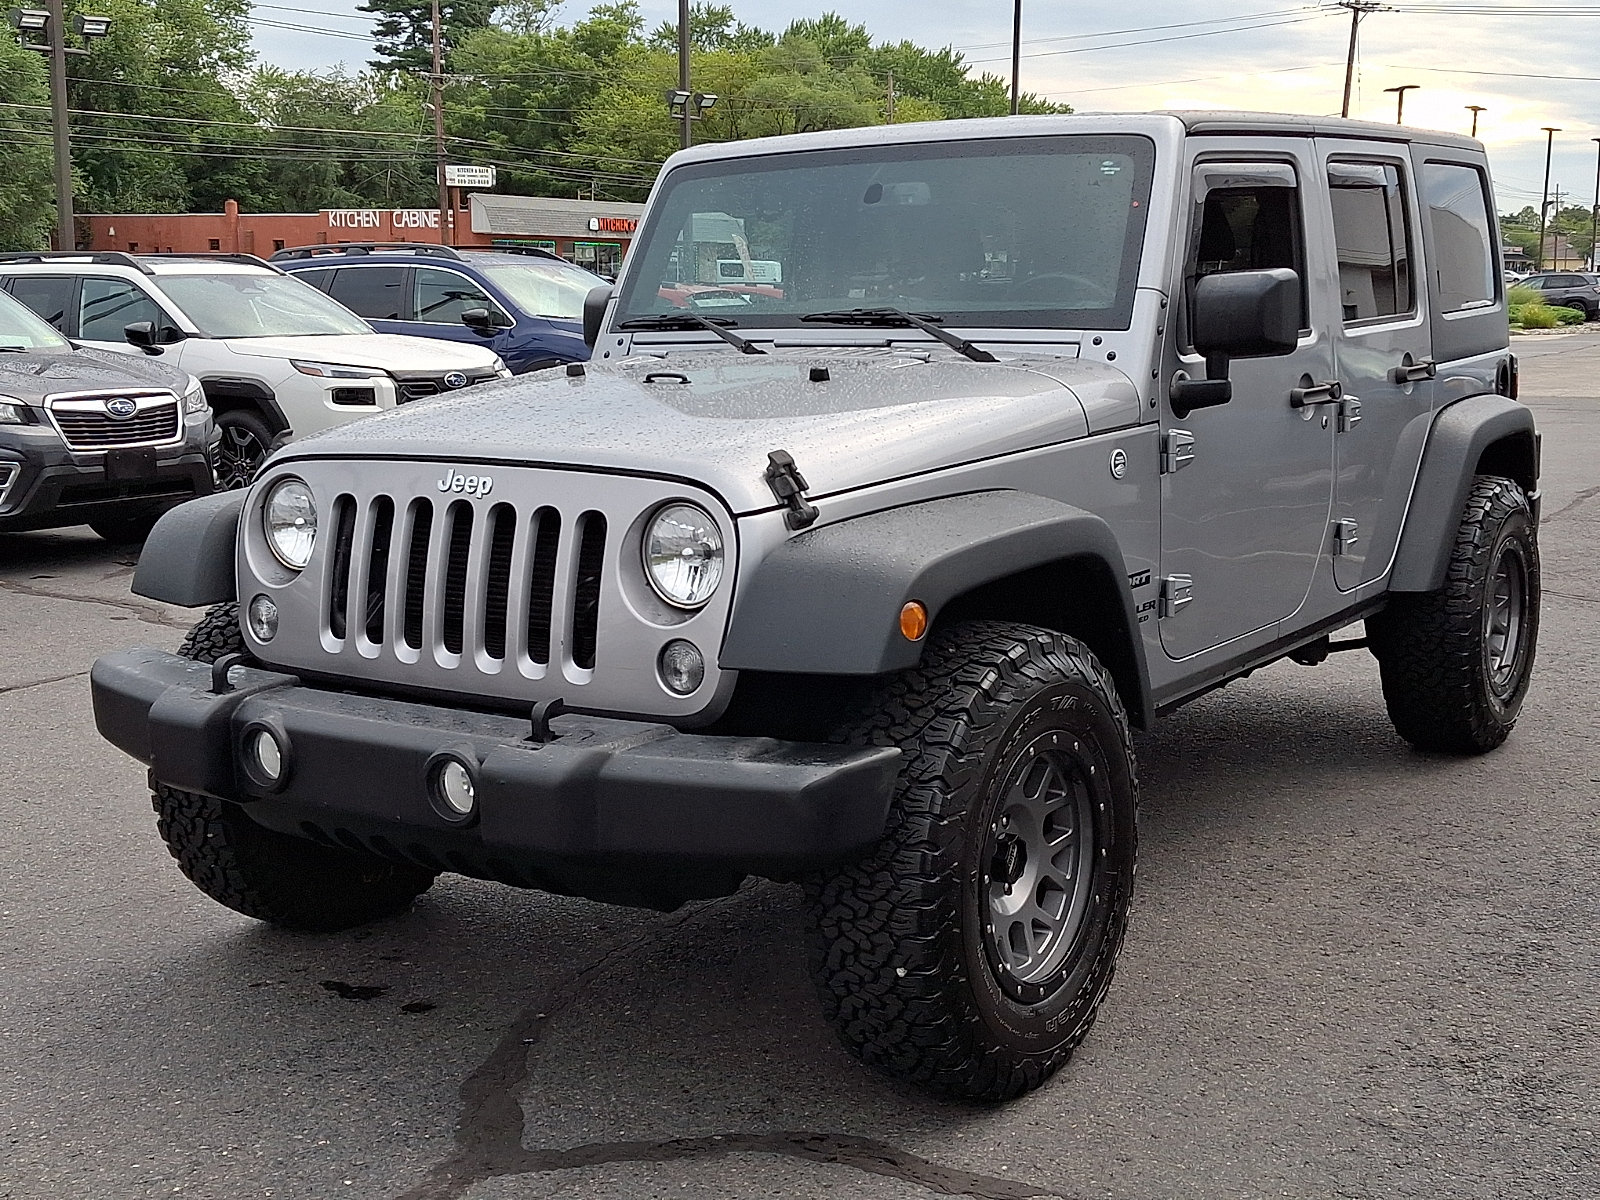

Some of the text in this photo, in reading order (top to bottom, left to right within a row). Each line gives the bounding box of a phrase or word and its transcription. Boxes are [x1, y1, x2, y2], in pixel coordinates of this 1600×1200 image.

[328, 211, 454, 228] KITCHEN CABINES
[598, 217, 629, 232] KITCHEN
[437, 469, 494, 500] Jeep
